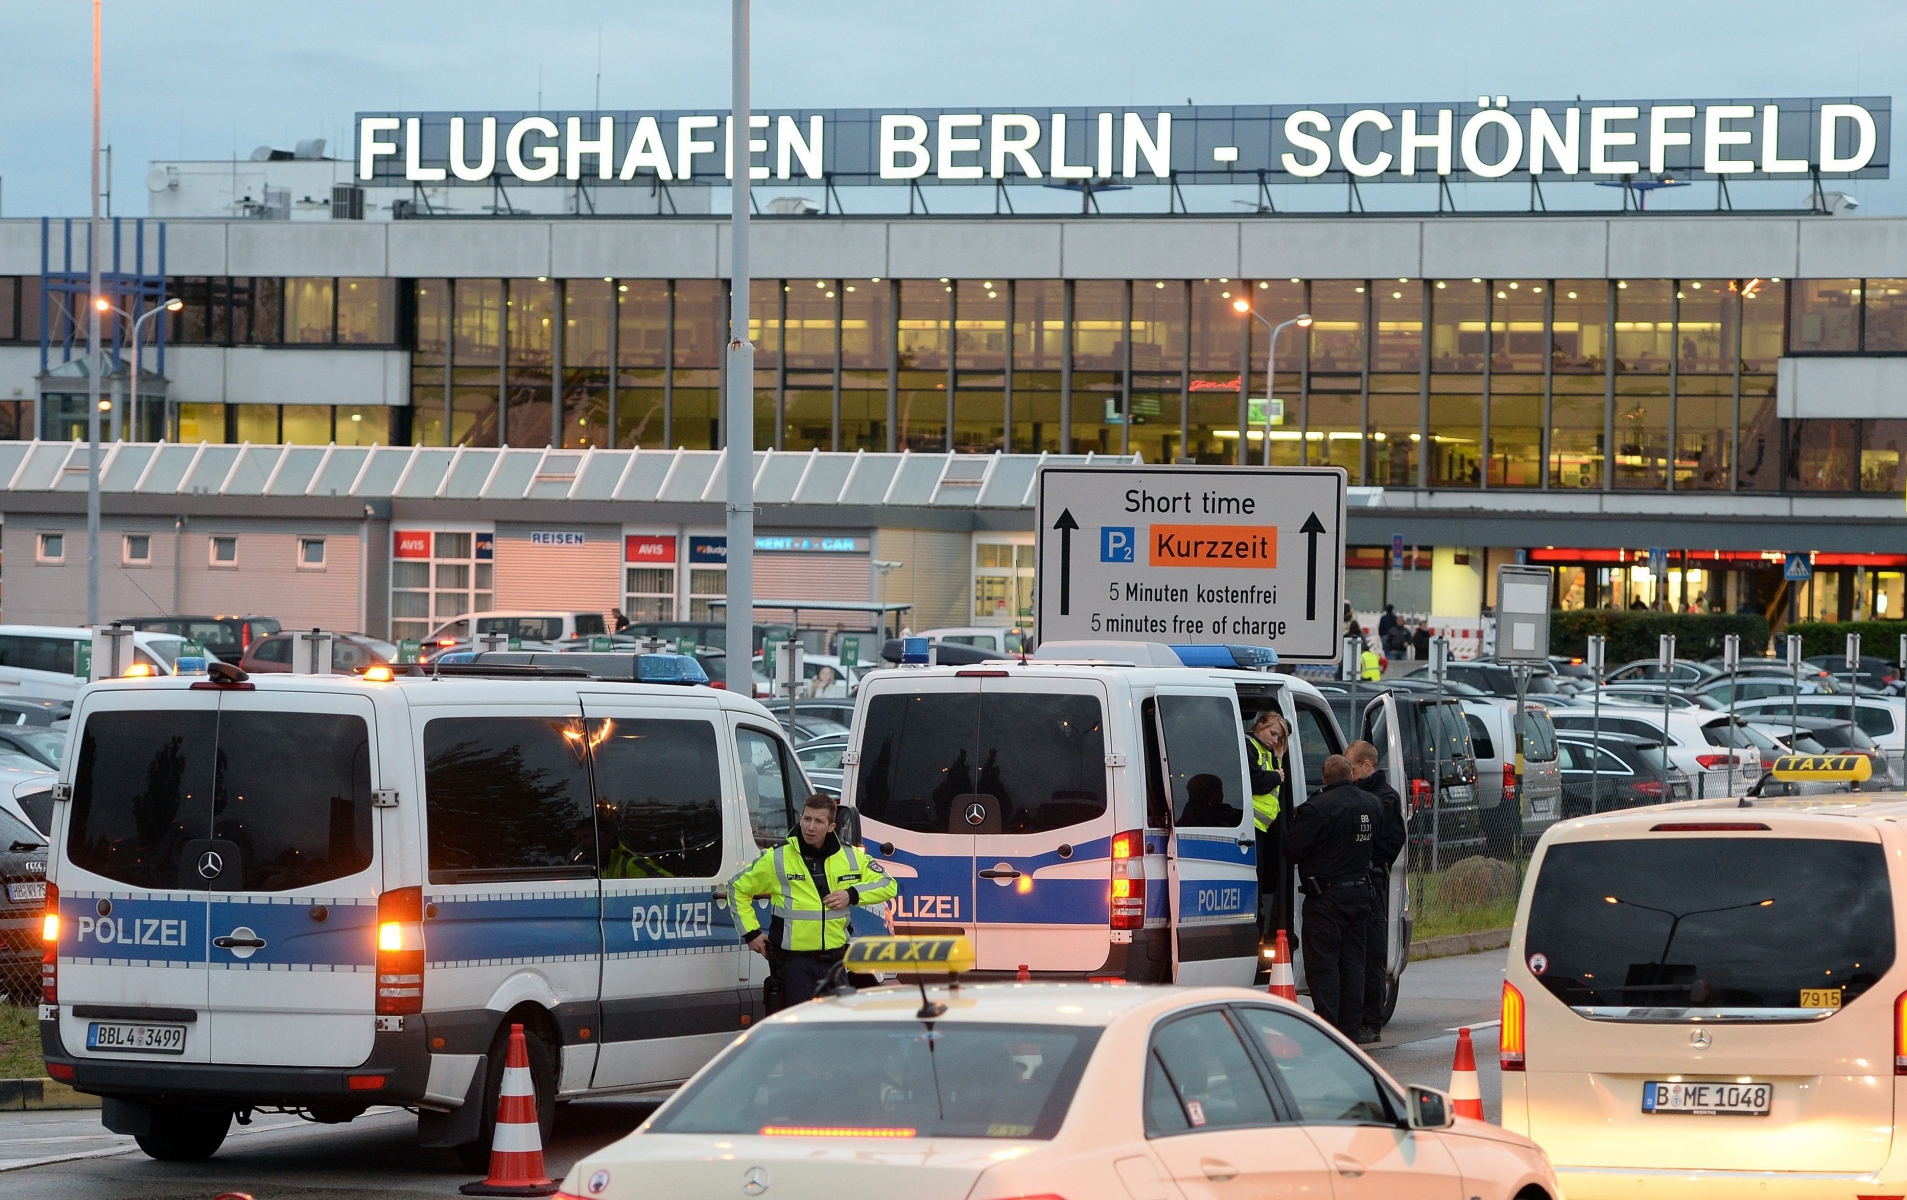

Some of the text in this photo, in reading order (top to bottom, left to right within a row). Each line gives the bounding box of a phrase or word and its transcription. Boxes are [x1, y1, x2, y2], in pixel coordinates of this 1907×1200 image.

[359, 115, 824, 182] FLUGHAFEN
[879, 112, 1172, 180] BERLIN
[1281, 95, 1878, 178] SCHÖNEFELD
[1124, 489, 1256, 514] Short time
[400, 539, 424, 551] AVIS
[532, 533, 584, 544] REISEN
[638, 543, 663, 555] AVIS
[1157, 533, 1268, 559] Kurzzeit
[1109, 582, 1277, 604] 5 Minuten kostenfrei
[1091, 613, 1286, 640] 5 minutes free of charge
[1788, 758, 1849, 770] TAXI
[889, 895, 960, 918] LIZEI
[1198, 888, 1241, 912] POLIZEI
[78, 916, 187, 947] POLIZEI
[632, 902, 713, 942] POLIZEI
[862, 940, 941, 960] TAXI
[1802, 991, 1840, 1006] 7915
[145, 1029, 181, 1047] 3499
[1656, 1086, 1669, 1106] B
[1683, 1086, 1710, 1107] ME
[1714, 1087, 1766, 1108] 1048
